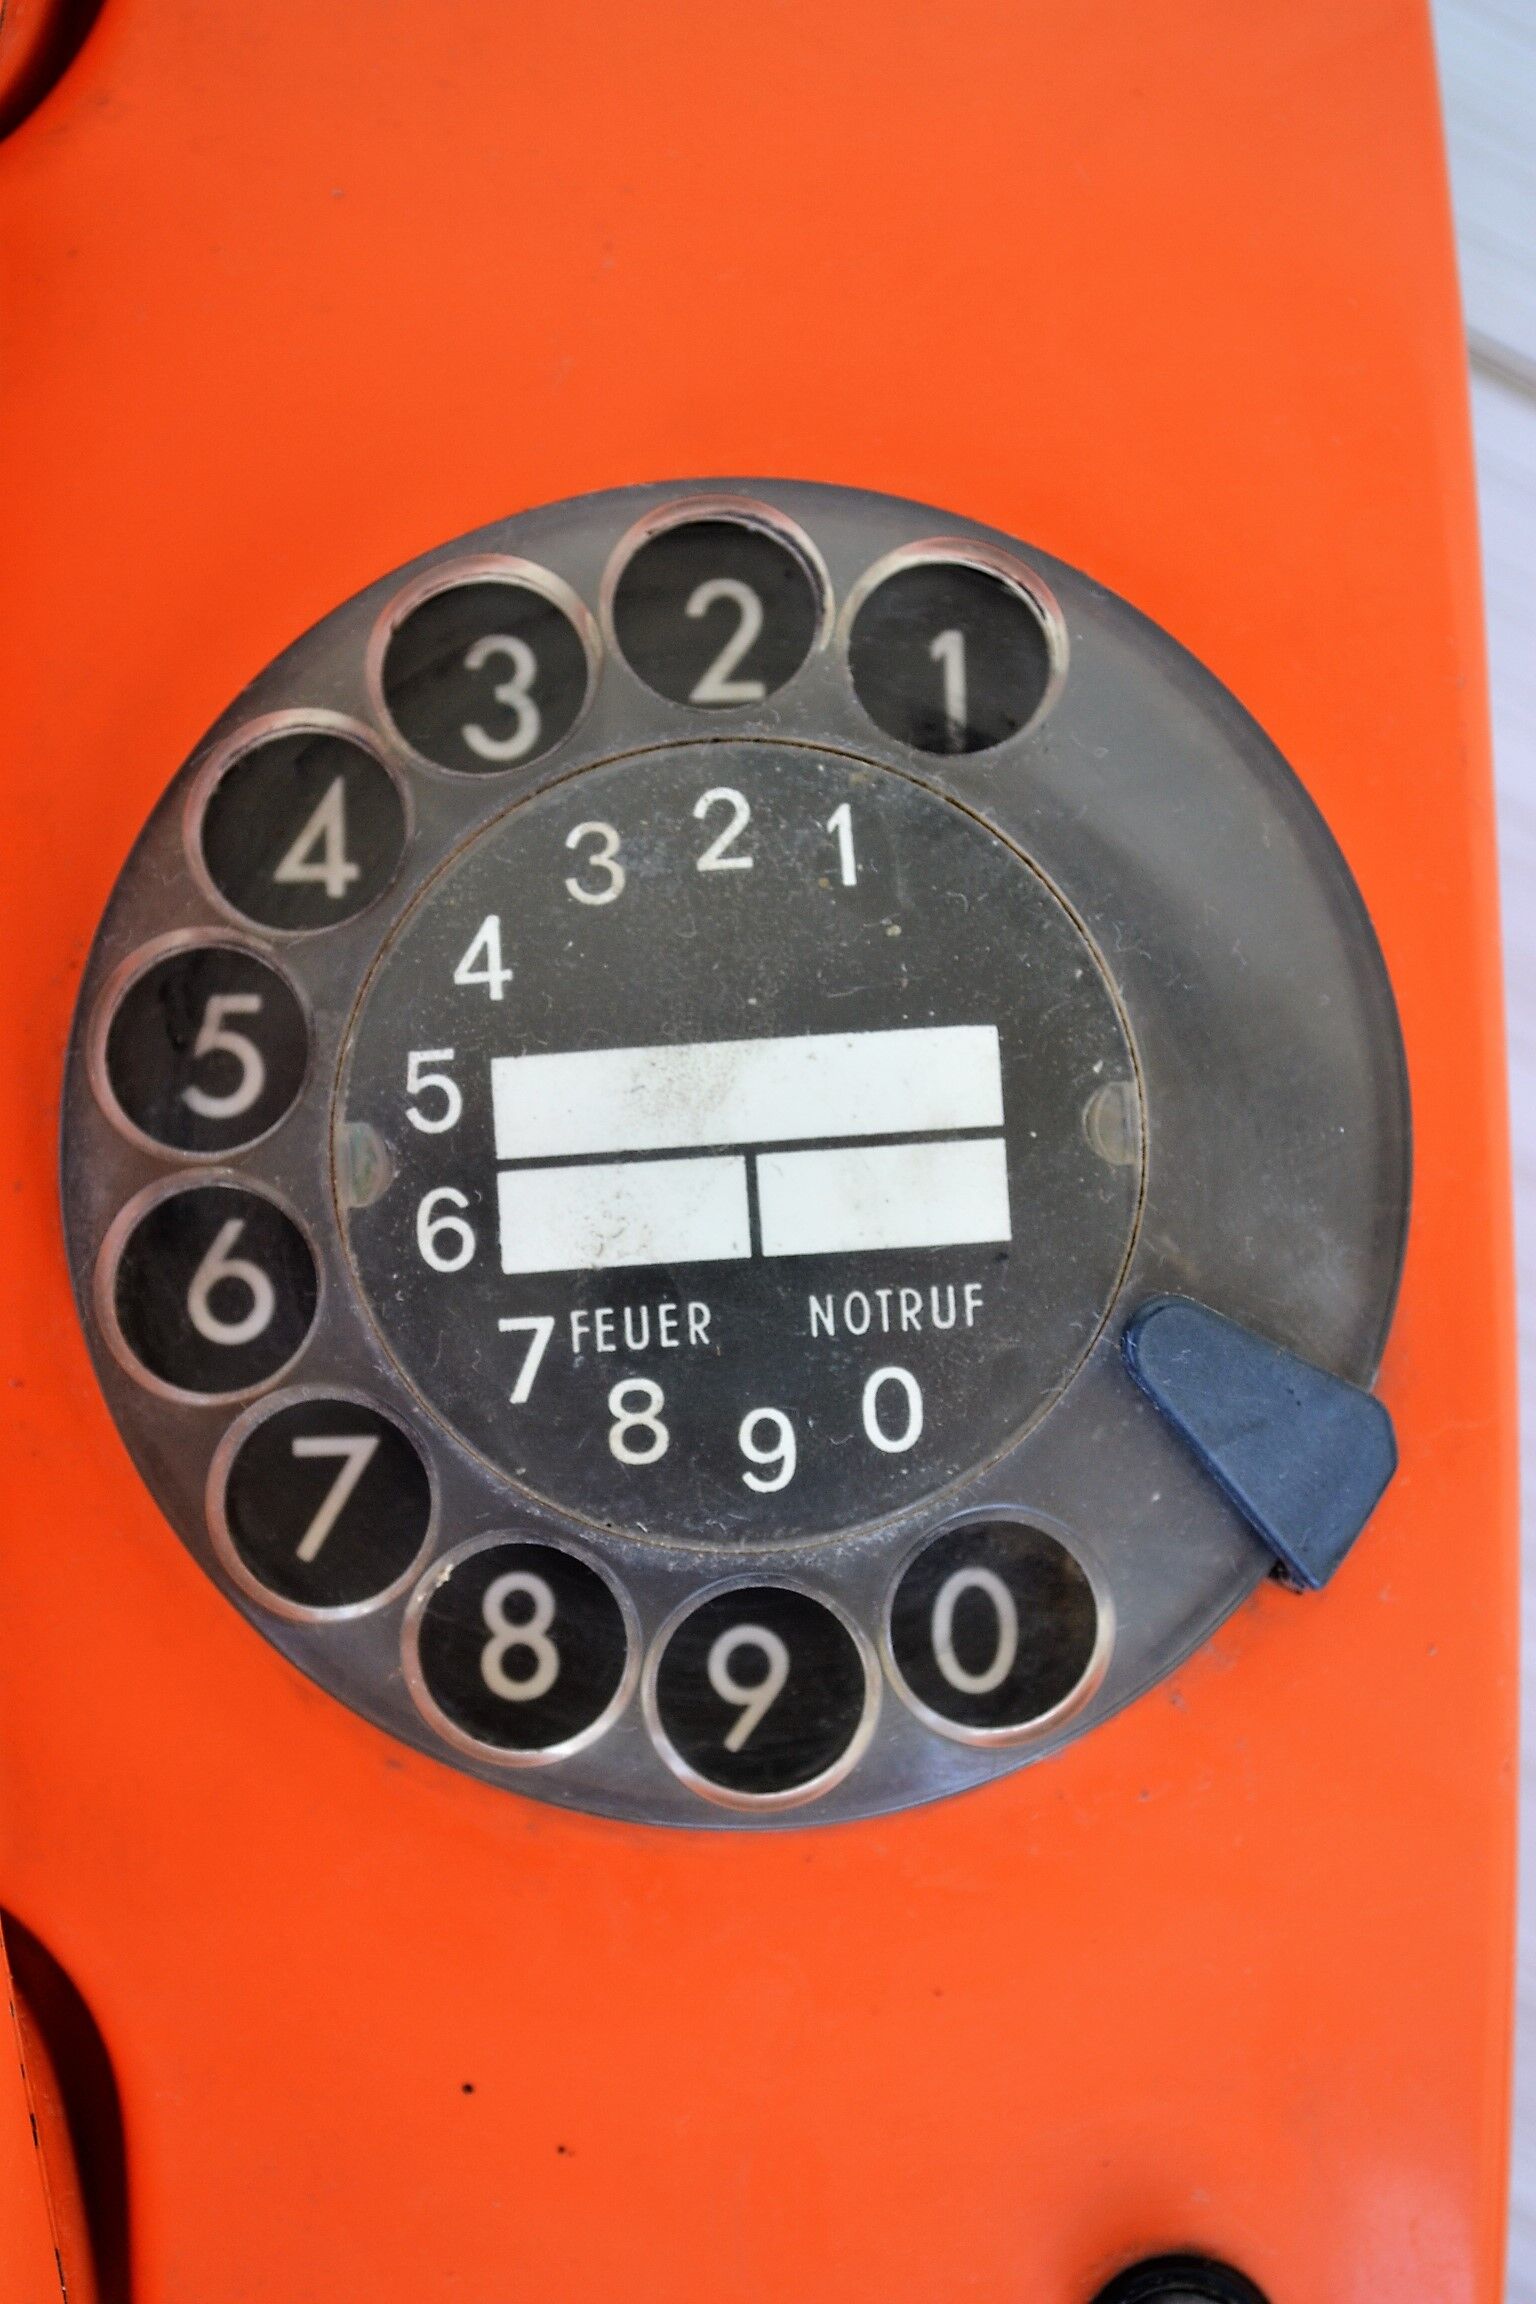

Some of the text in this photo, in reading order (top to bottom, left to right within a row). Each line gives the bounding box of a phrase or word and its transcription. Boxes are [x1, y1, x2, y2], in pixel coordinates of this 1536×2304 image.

[687, 580, 767, 702] 2
[463, 635, 541, 761] 3
[929, 629, 968, 748] 1
[274, 778, 359, 900] 4
[564, 821, 626, 905] 3
[692, 786, 754, 871] 2
[826, 802, 858, 887] 1
[453, 915, 514, 1001] 4
[184, 993, 264, 1118] 5
[405, 1049, 463, 1134] 5
[416, 1187, 476, 1273] 6
[188, 1220, 275, 1345] 6
[808, 1282, 984, 1338] NOTRUF
[498, 1316, 555, 1402] 7
[570, 1301, 711, 1354] FEUER
[608, 1378, 670, 1464] 8
[738, 1407, 797, 1493] 9
[862, 1366, 924, 1452] 0
[292, 1436, 379, 1560] 7
[481, 1572, 559, 1702] 8
[931, 1568, 1018, 1694] 0
[708, 1625, 789, 1752] 9
